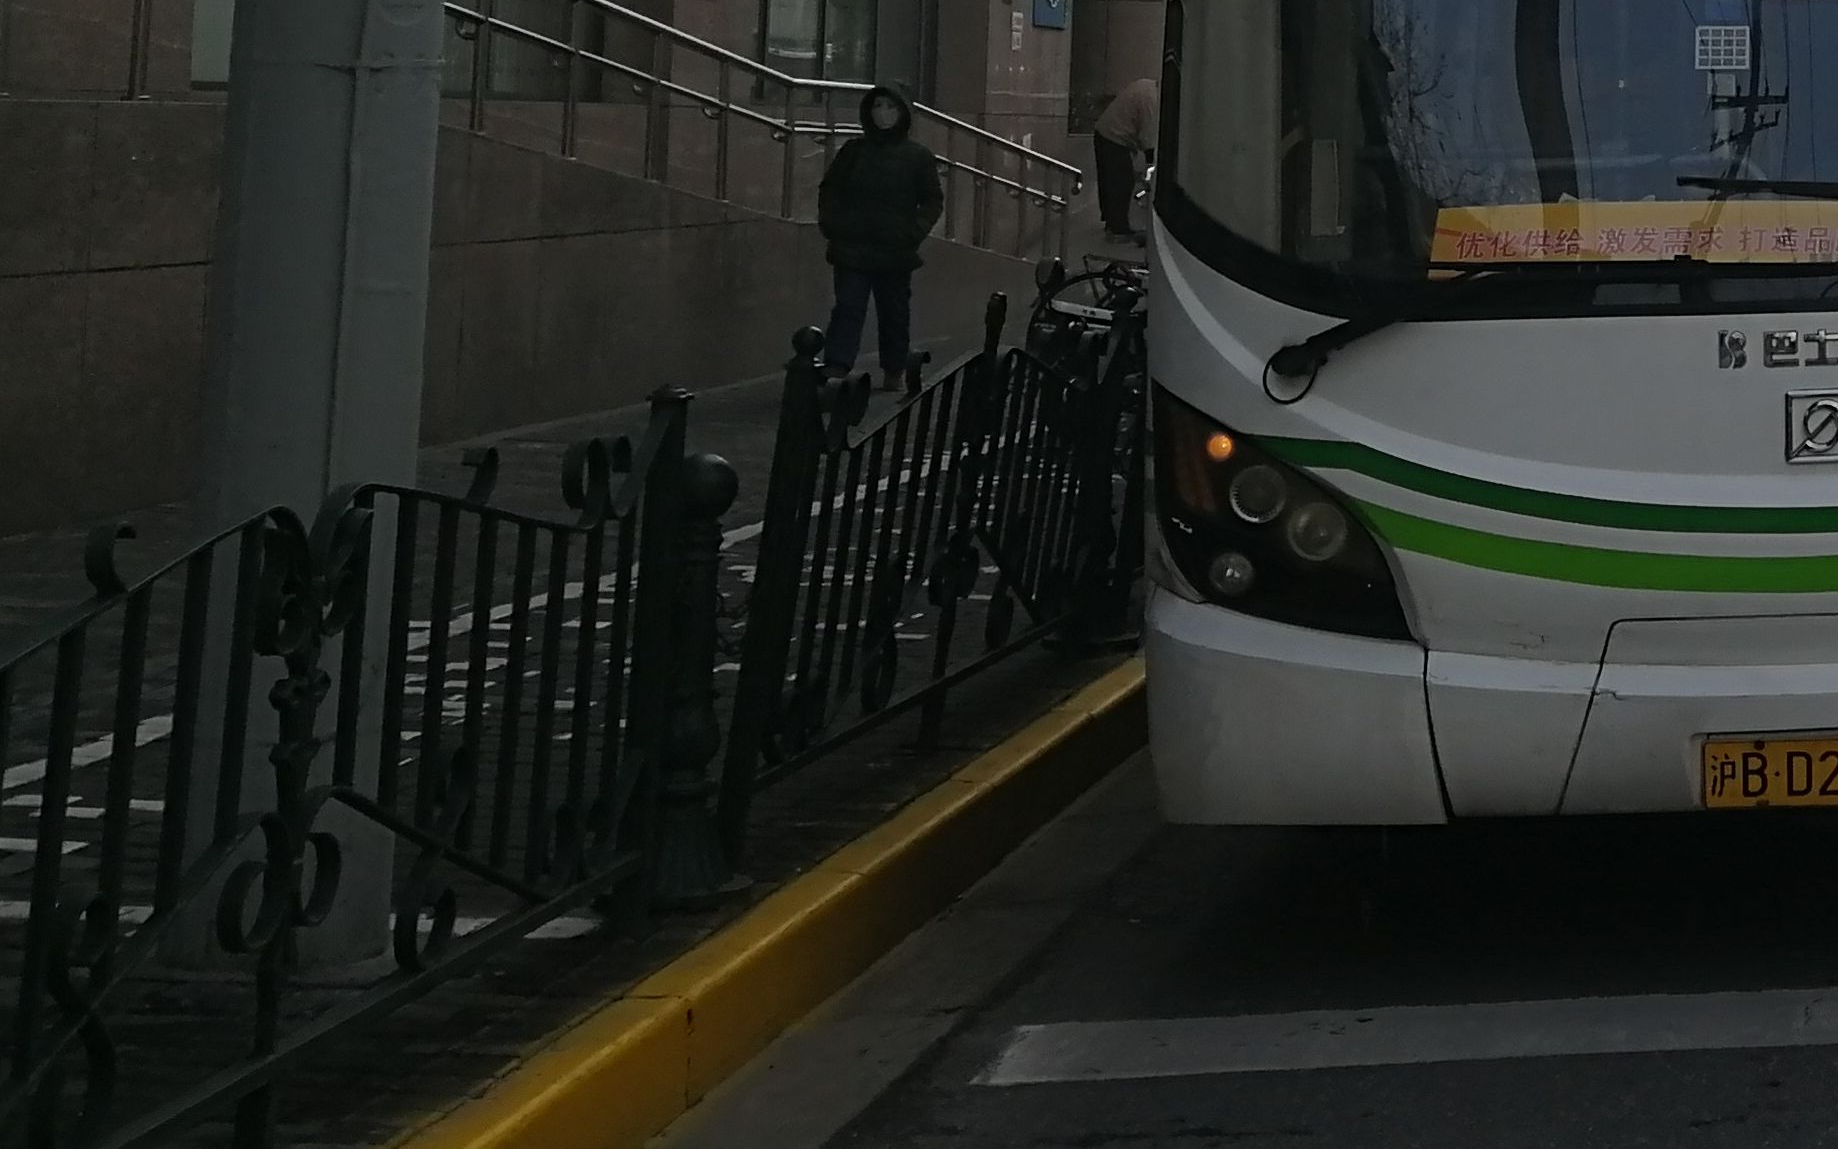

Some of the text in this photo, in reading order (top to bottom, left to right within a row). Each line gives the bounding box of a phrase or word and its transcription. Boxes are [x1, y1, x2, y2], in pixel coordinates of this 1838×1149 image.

[1455, 227, 1585, 260] 优化供给
[1598, 226, 1725, 254] 激发需求
